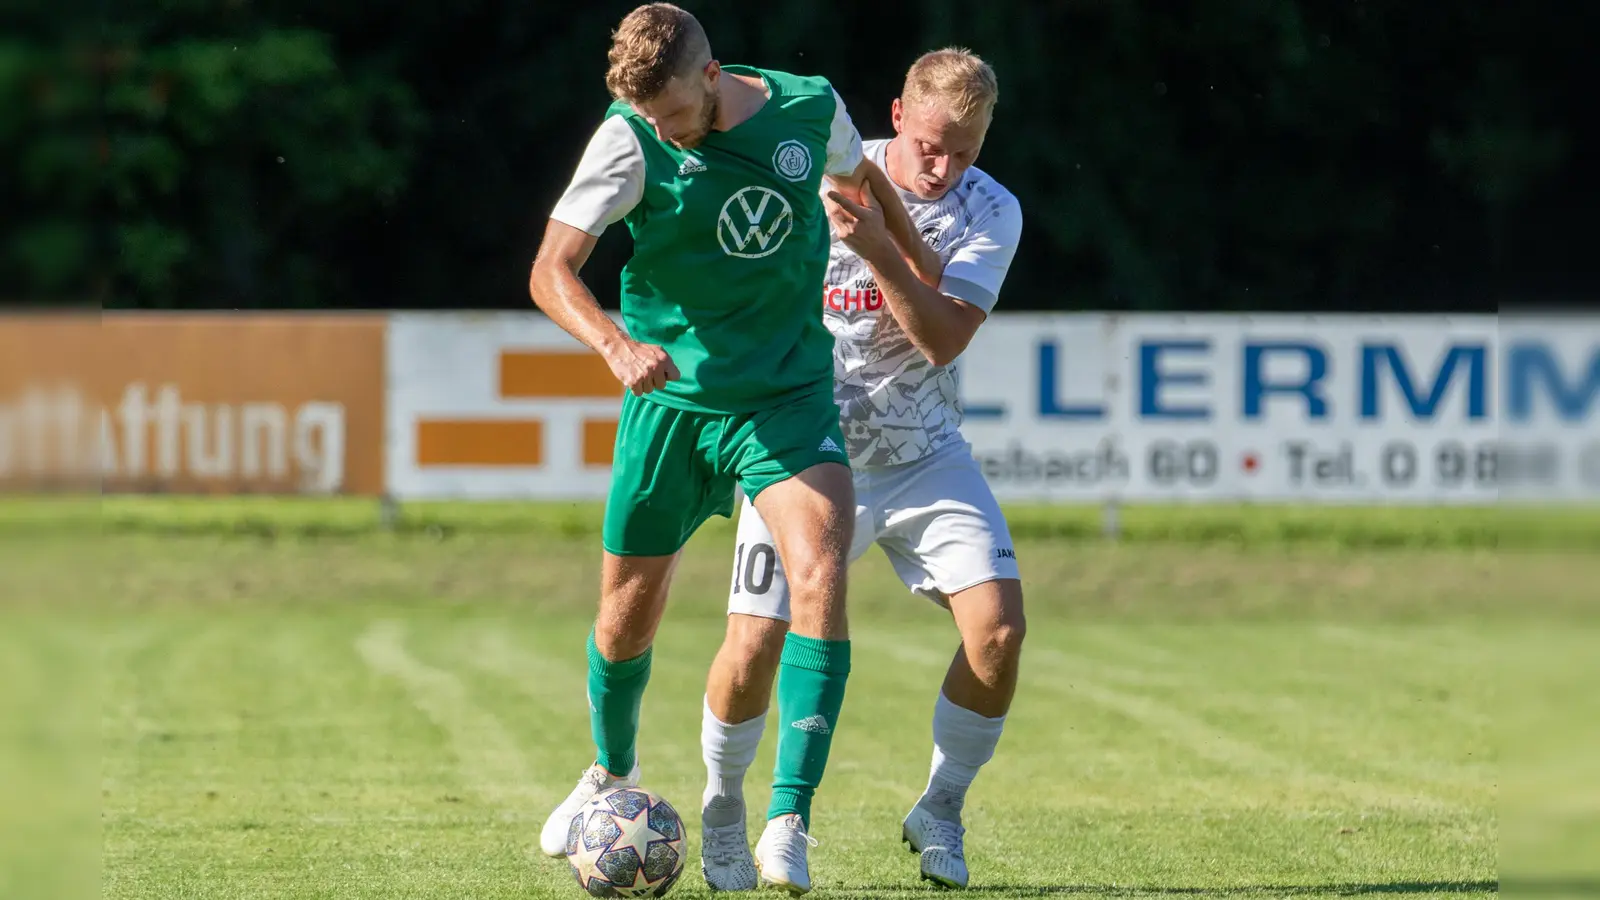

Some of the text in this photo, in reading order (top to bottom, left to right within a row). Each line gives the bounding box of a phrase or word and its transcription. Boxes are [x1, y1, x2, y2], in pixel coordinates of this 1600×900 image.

[678, 164, 707, 175] adidas
[855, 279, 878, 289] Wo
[818, 446, 842, 454] adidas
[734, 543, 775, 595] 10
